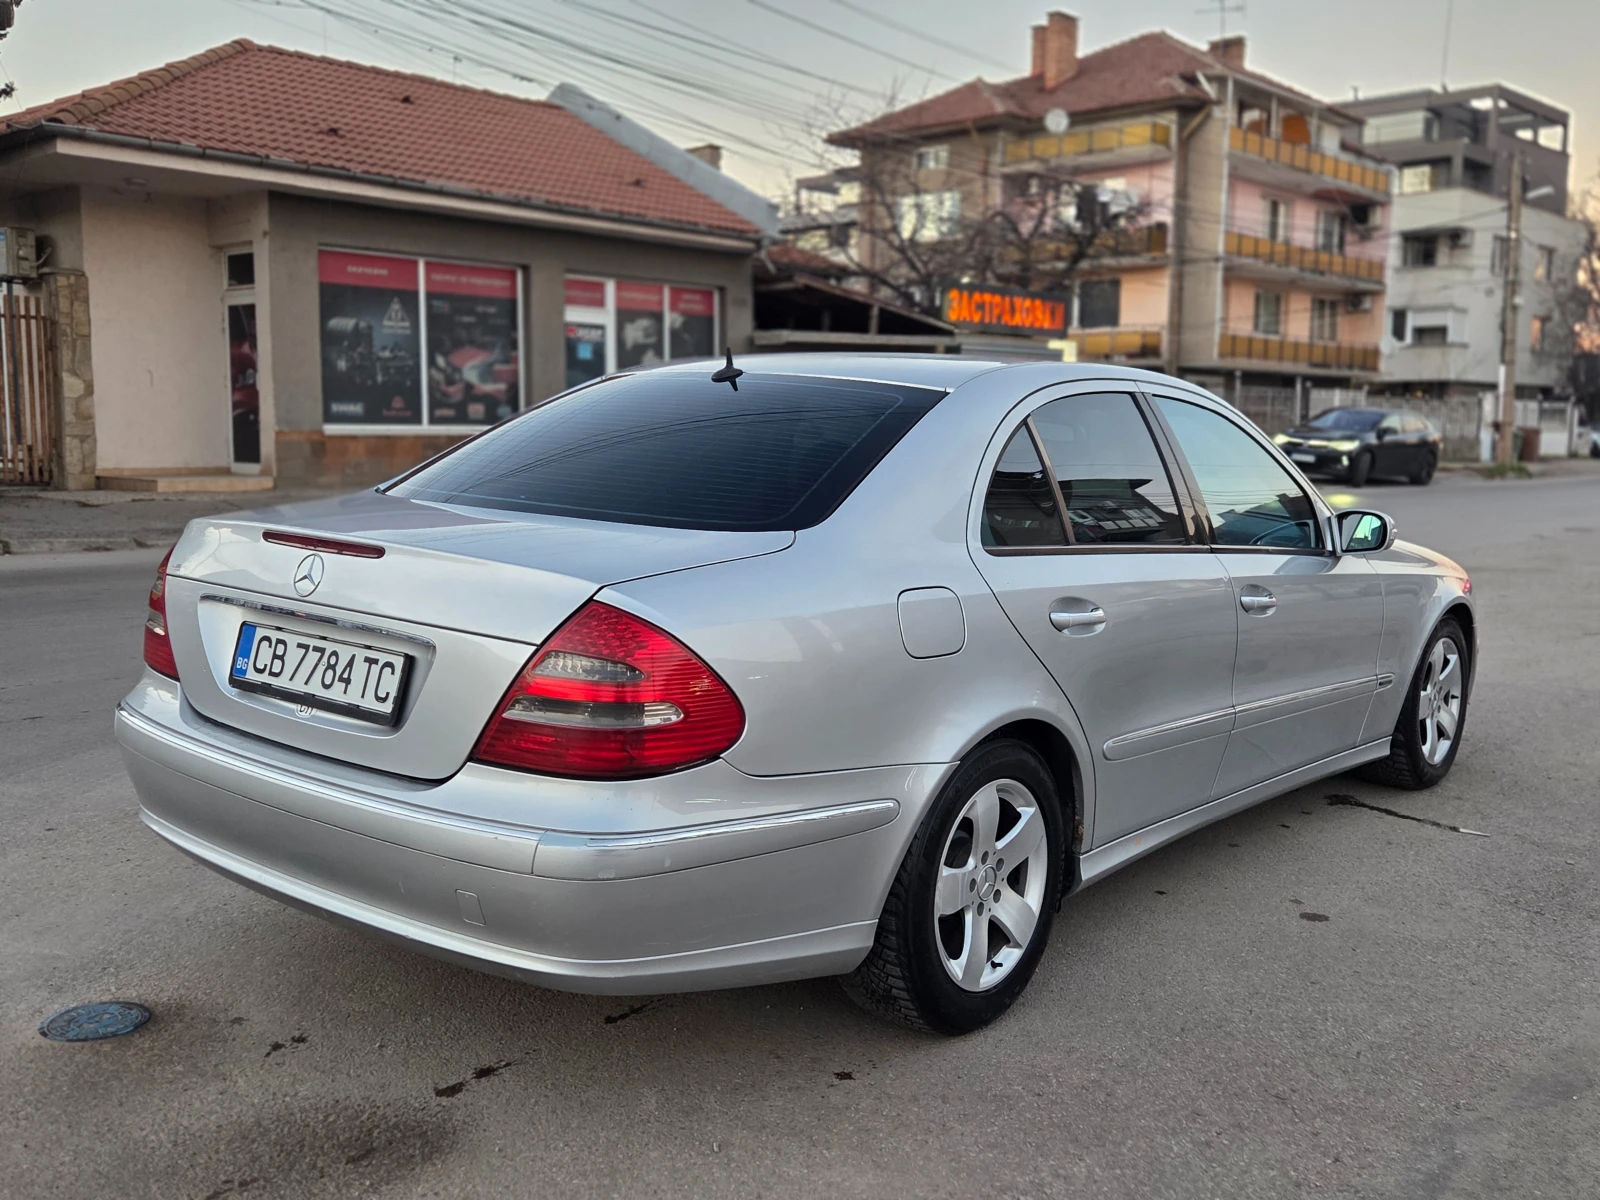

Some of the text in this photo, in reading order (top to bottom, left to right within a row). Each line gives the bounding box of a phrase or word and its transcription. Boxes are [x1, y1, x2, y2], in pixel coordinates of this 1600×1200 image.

[236, 657, 248, 670] BG
[252, 635, 396, 704] CB 7784 TC
